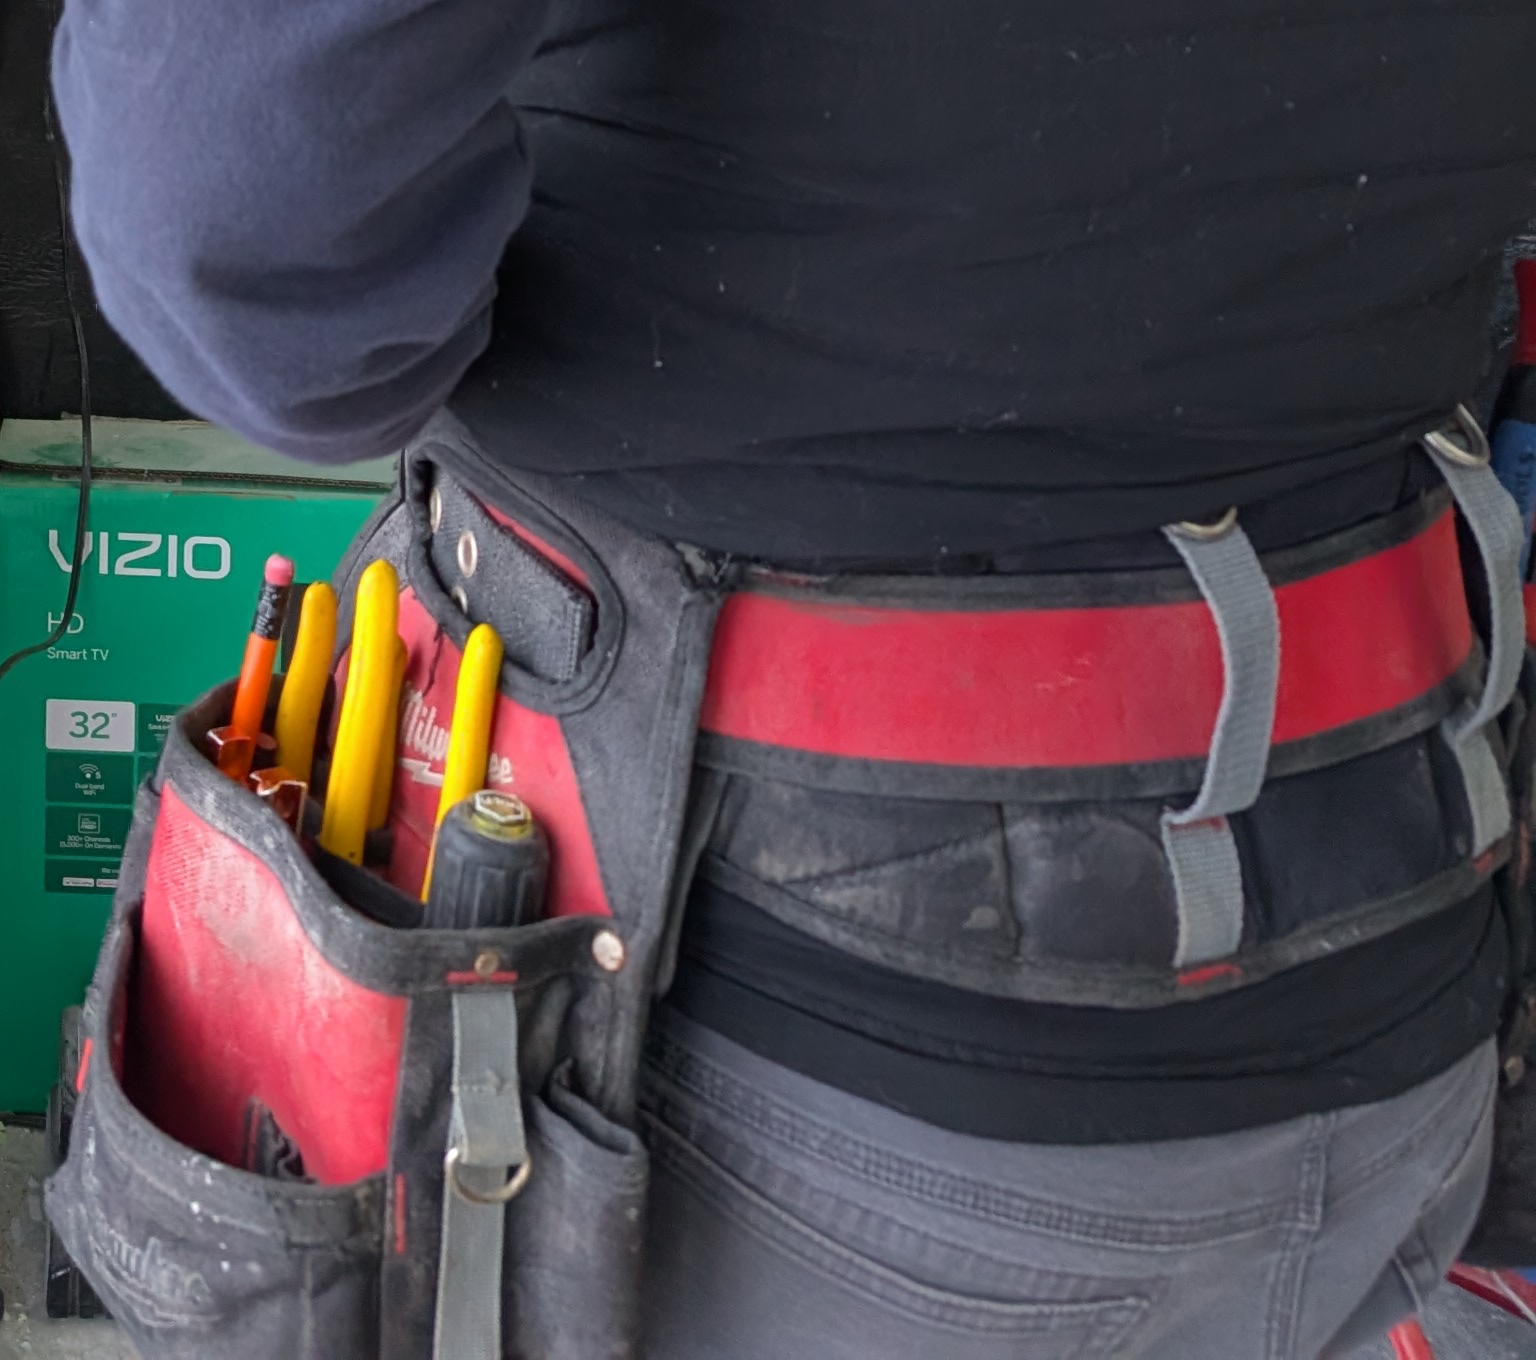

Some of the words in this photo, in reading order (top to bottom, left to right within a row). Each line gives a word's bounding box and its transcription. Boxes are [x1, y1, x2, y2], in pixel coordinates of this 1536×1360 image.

[48, 529, 231, 580] VIZIO
[47, 611, 85, 634] HD
[47, 646, 88, 661] Smart
[91, 648, 110, 661] TV
[401, 689, 514, 785] Milwee
